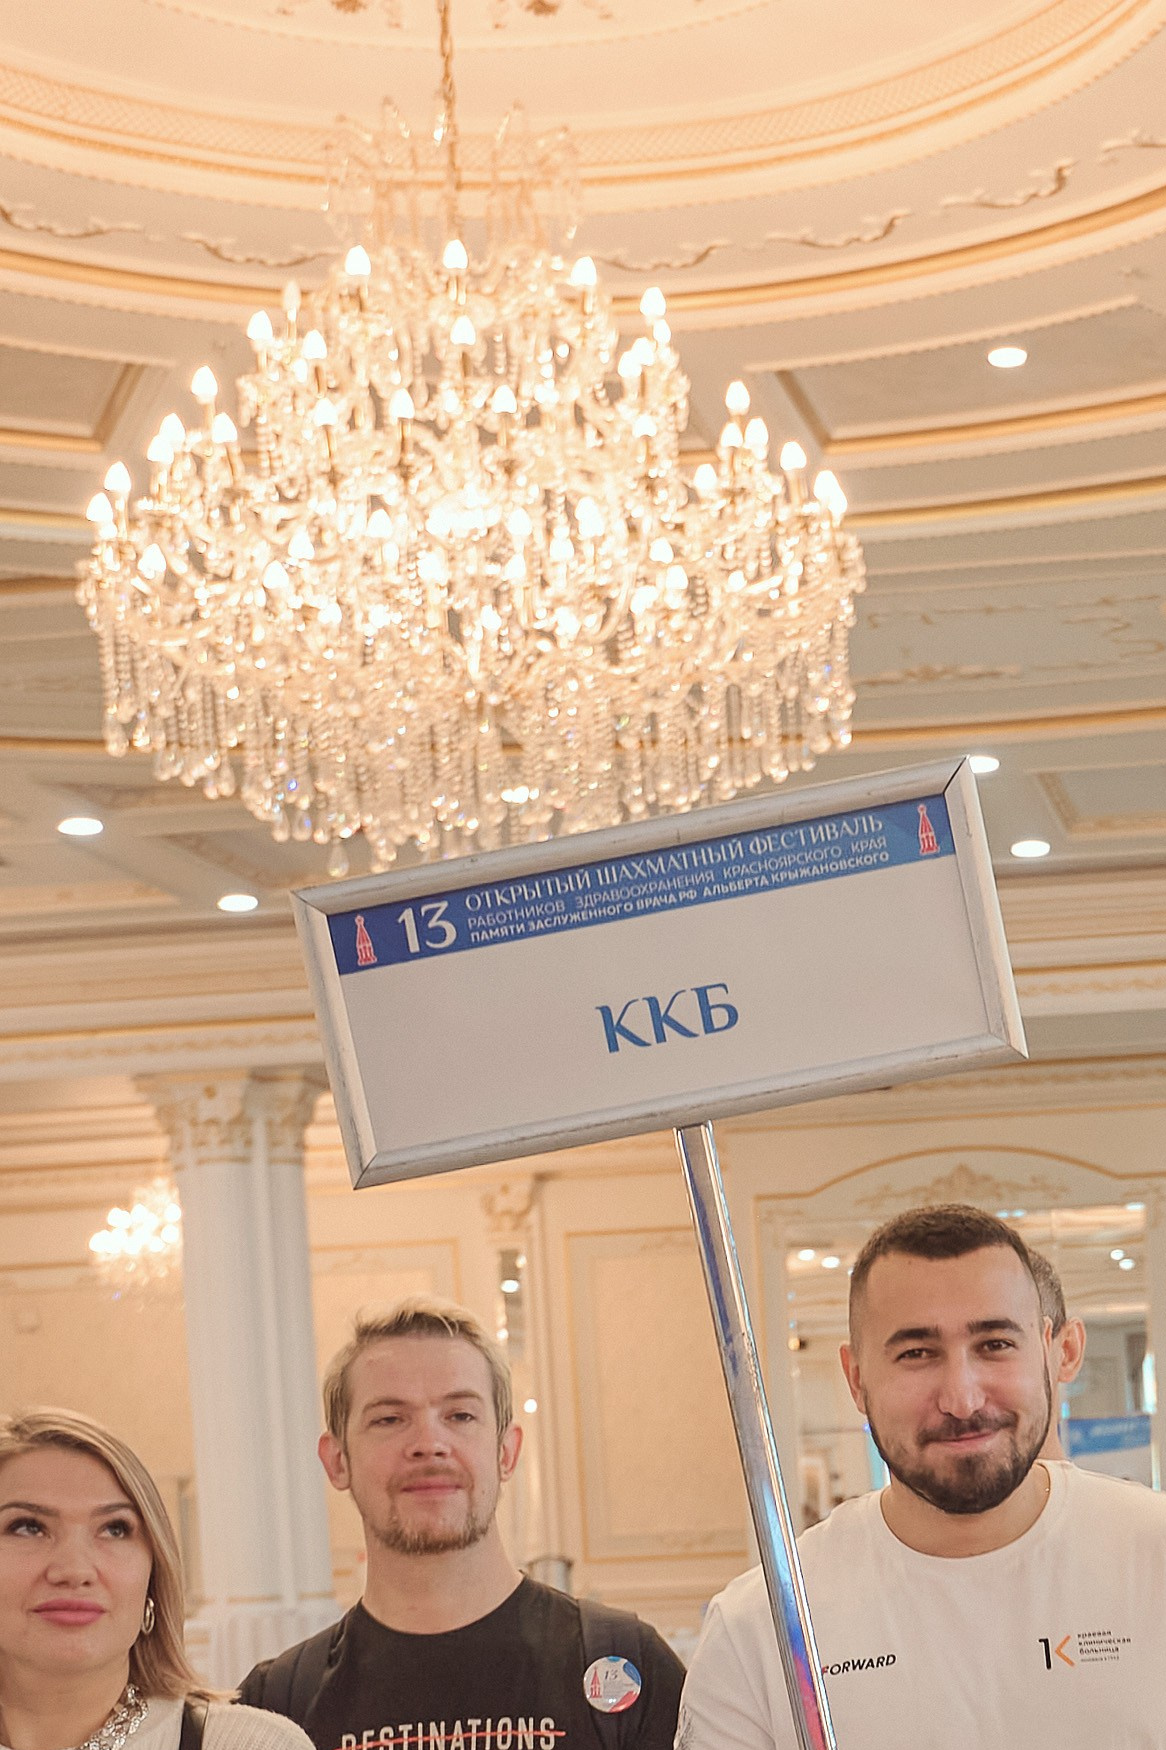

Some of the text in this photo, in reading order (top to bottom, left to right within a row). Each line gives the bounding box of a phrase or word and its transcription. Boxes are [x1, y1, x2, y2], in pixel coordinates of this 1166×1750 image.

[397, 815, 883, 953] 13 ОТКРЫТЫЙ ШАХМАТНЫЙ ФЕСТИВАЛЬ
[467, 835, 888, 929] РАБОТНИКОВ ЗДРАВООХРАНЕНИЯ КРАСНОЯРСКОГО КРАЯ
[470, 851, 889, 944] ПАМЯТИ ЗАСЛУЖЕННОГО ВРАЧА РФ АЛЬБЕРТА КРЫЖАНОВСКОГО
[595, 983, 739, 1053] ККБ
